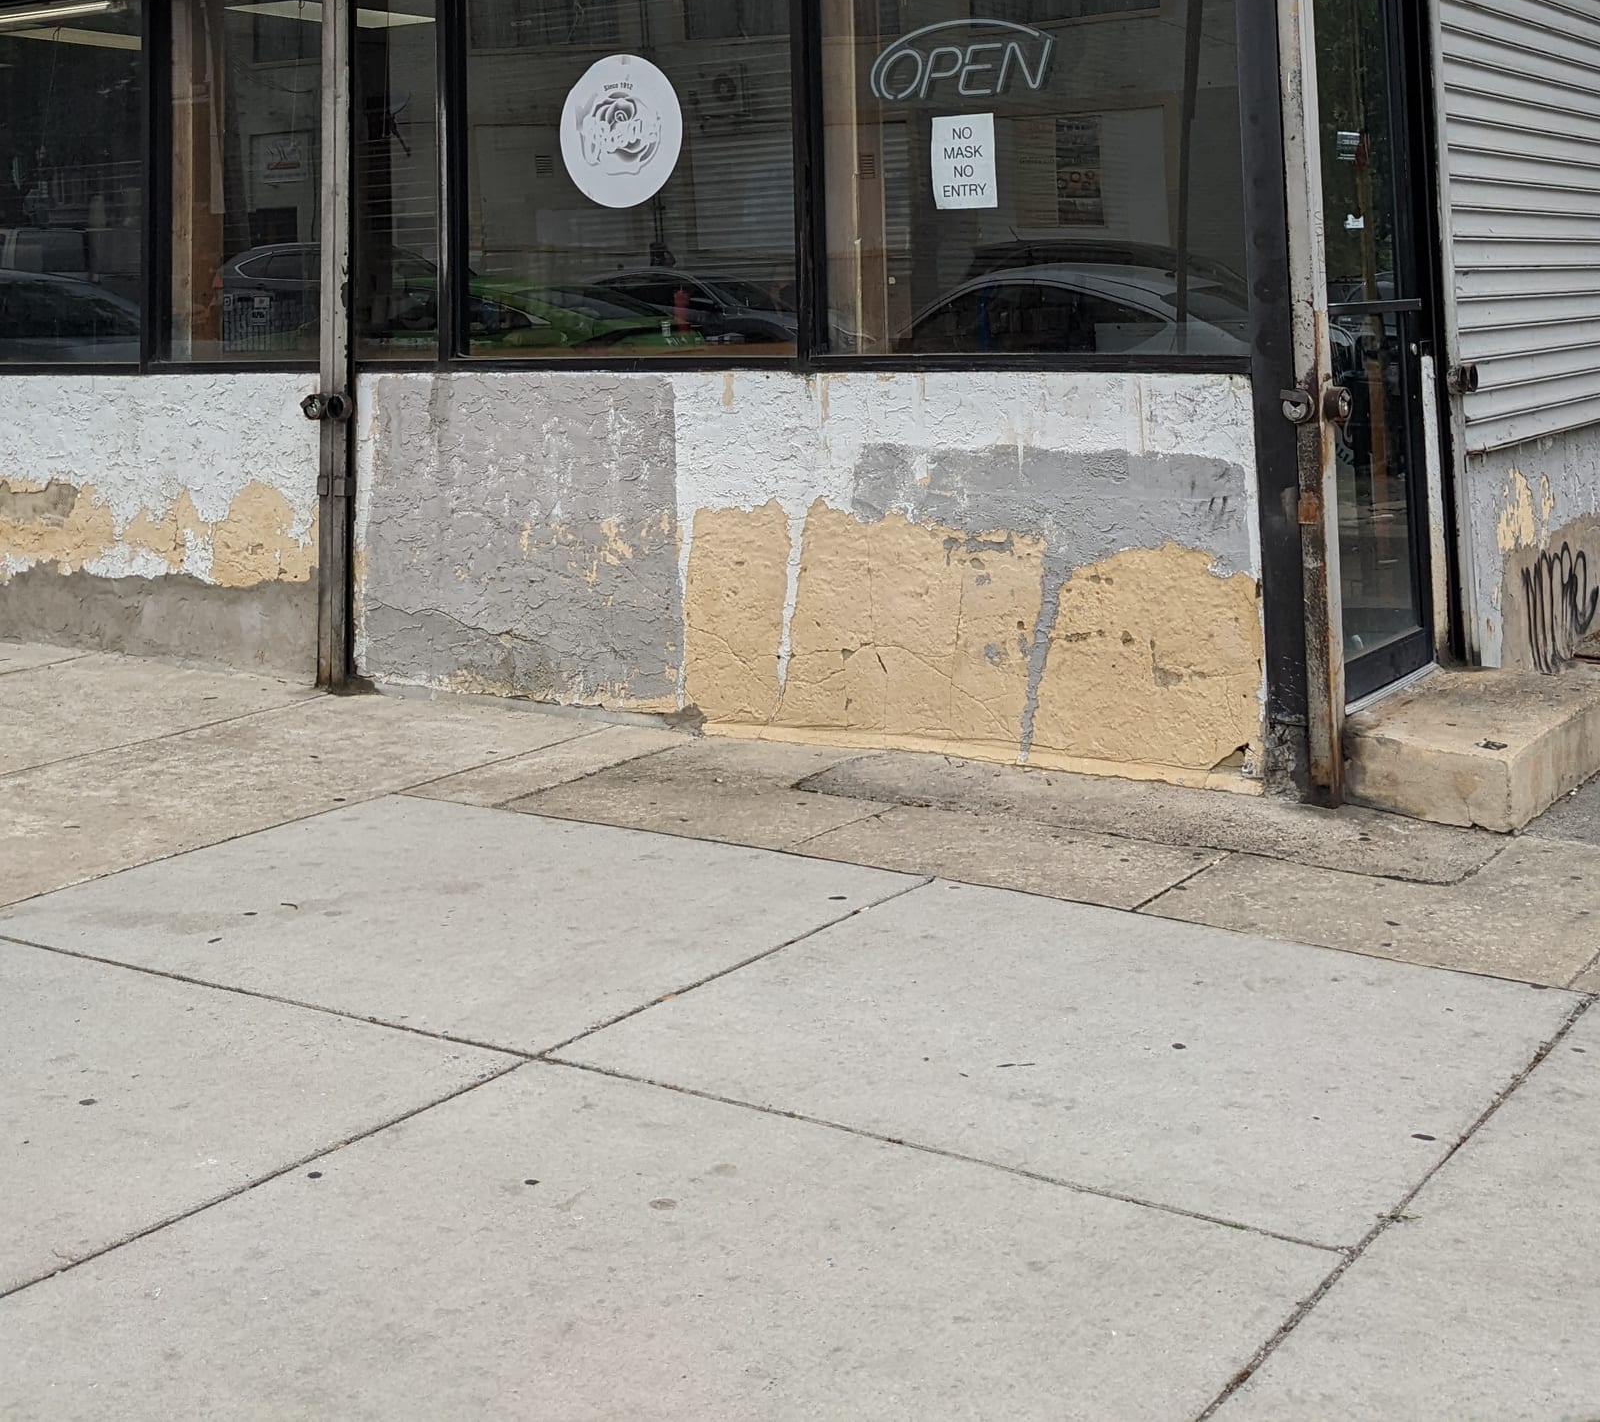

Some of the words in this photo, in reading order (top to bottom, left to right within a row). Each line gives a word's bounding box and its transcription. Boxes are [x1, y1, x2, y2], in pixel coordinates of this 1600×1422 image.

[880, 39, 1052, 100] OPEN
[952, 127, 973, 140] NO
[943, 145, 983, 159] MASK
[953, 164, 974, 178] NO
[942, 183, 987, 198] ENTRY
